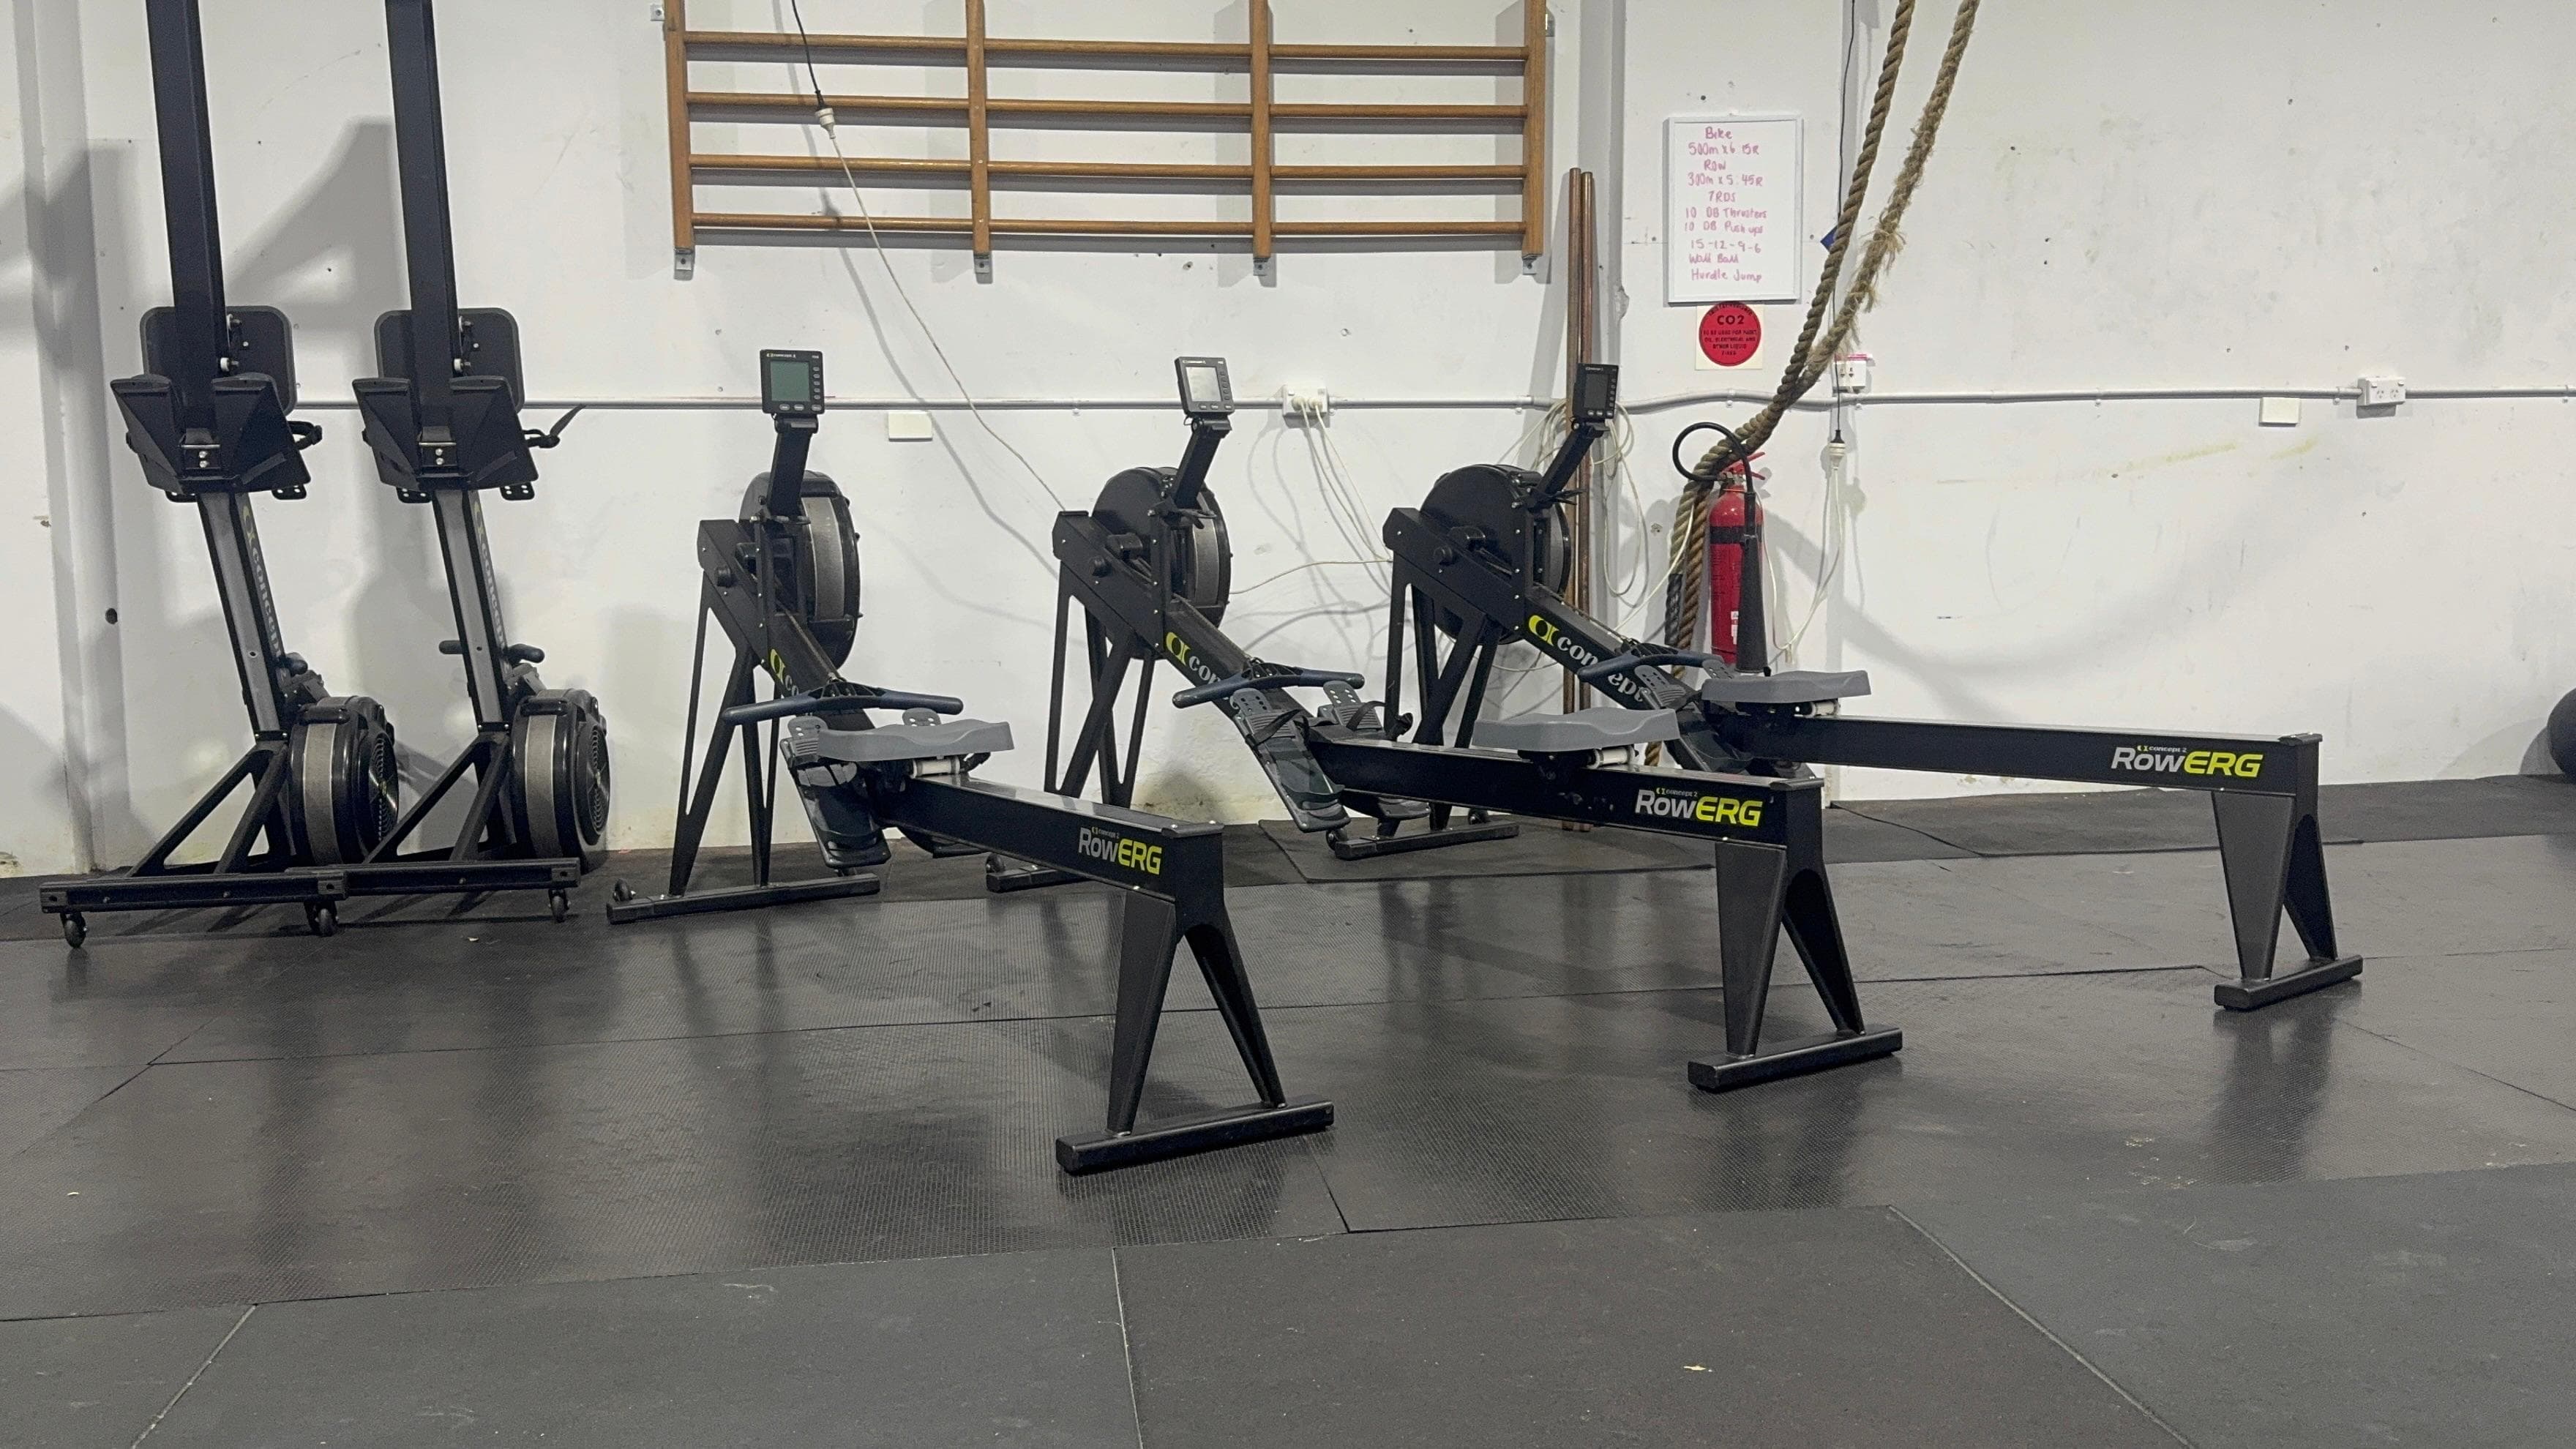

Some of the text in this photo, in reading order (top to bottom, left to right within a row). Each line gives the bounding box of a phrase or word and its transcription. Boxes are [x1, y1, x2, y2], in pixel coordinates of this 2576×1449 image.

[1705, 126, 1733, 139] Bike
[1688, 142, 1718, 155] 500m
[1688, 172, 1713, 187] 300m
[1685, 206, 1767, 219] 10 DB Thrusters
[1685, 221, 1695, 231] 10
[1689, 252, 1739, 263] Wall Ball
[1691, 268, 1762, 283] Hurdle Jump
[1717, 315, 1745, 325] CO2
[1557, 636, 1644, 702] conept
[2111, 746, 2264, 777] RowERG
[1635, 789, 1763, 827] RowERG
[1078, 827, 1162, 875] RowERG
